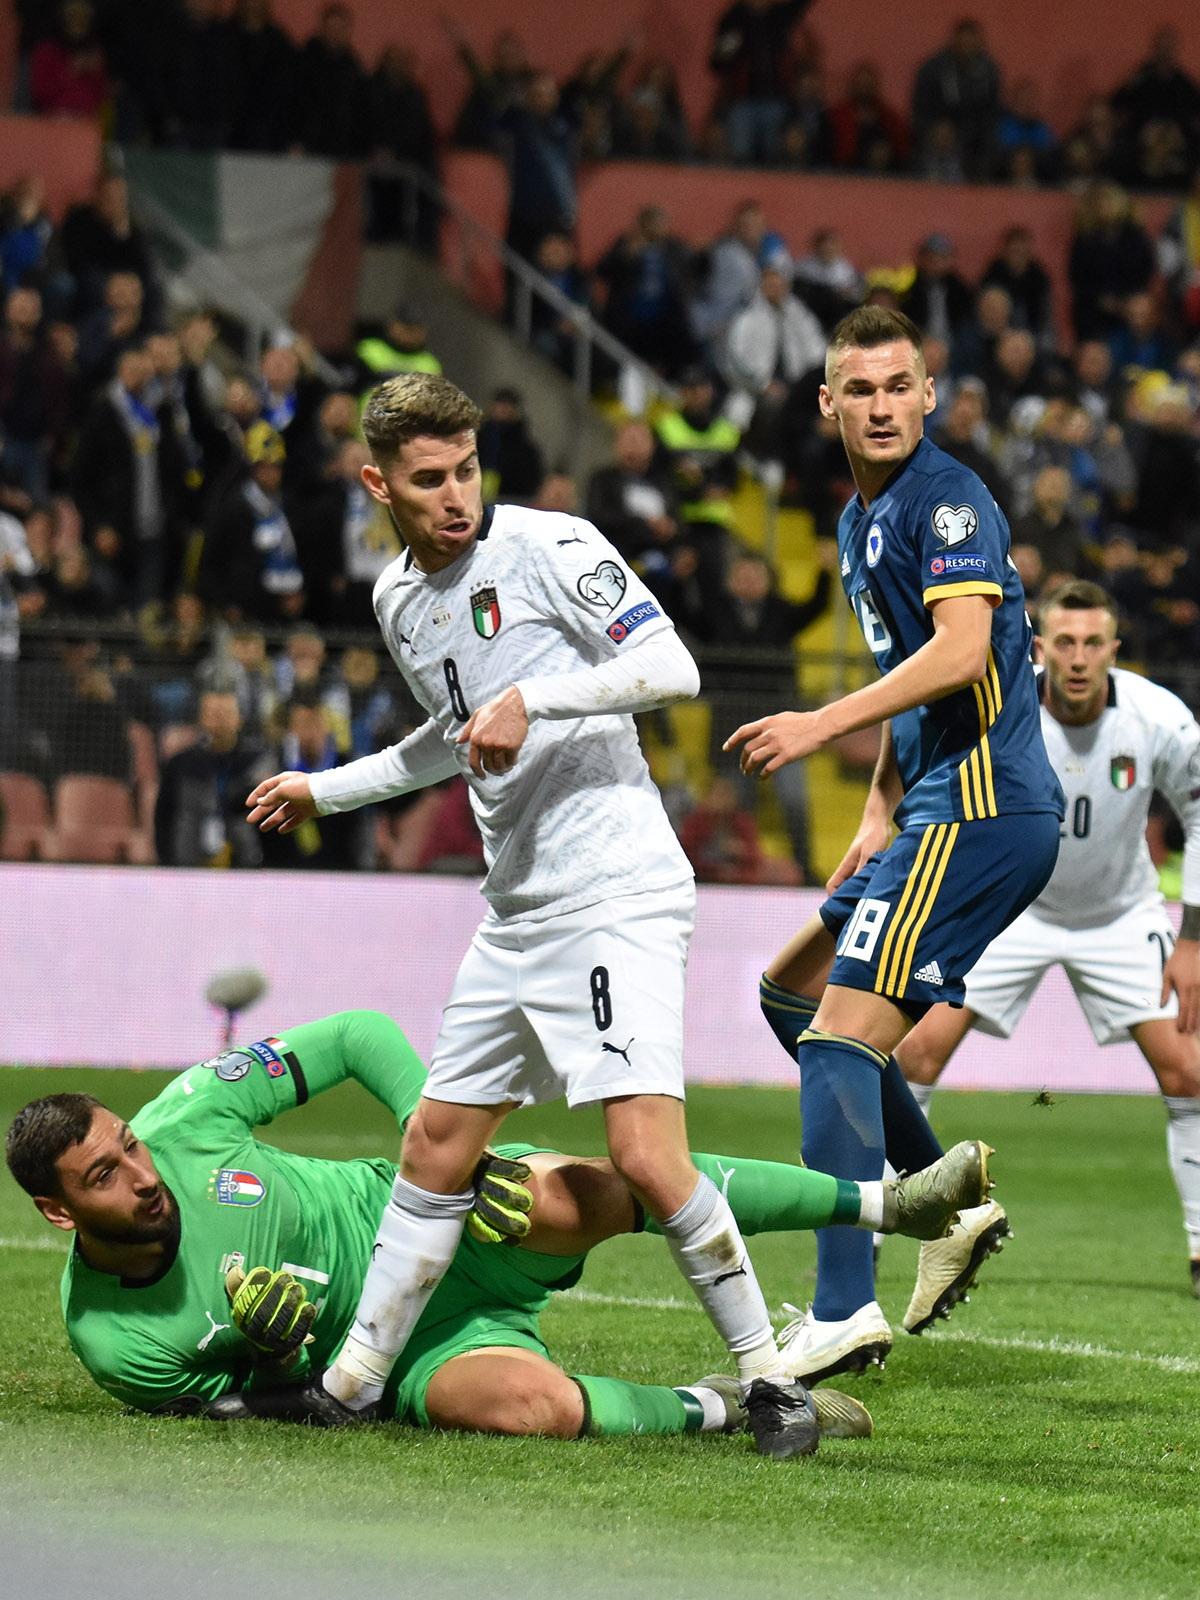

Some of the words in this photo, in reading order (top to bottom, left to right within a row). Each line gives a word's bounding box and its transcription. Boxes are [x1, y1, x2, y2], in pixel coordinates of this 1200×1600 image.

[945, 558, 986, 569] RESPECT
[443, 658, 471, 722] 8
[913, 971, 945, 986] adidas
[590, 965, 613, 1031] 8
[219, 1171, 230, 1202] ITALIA
